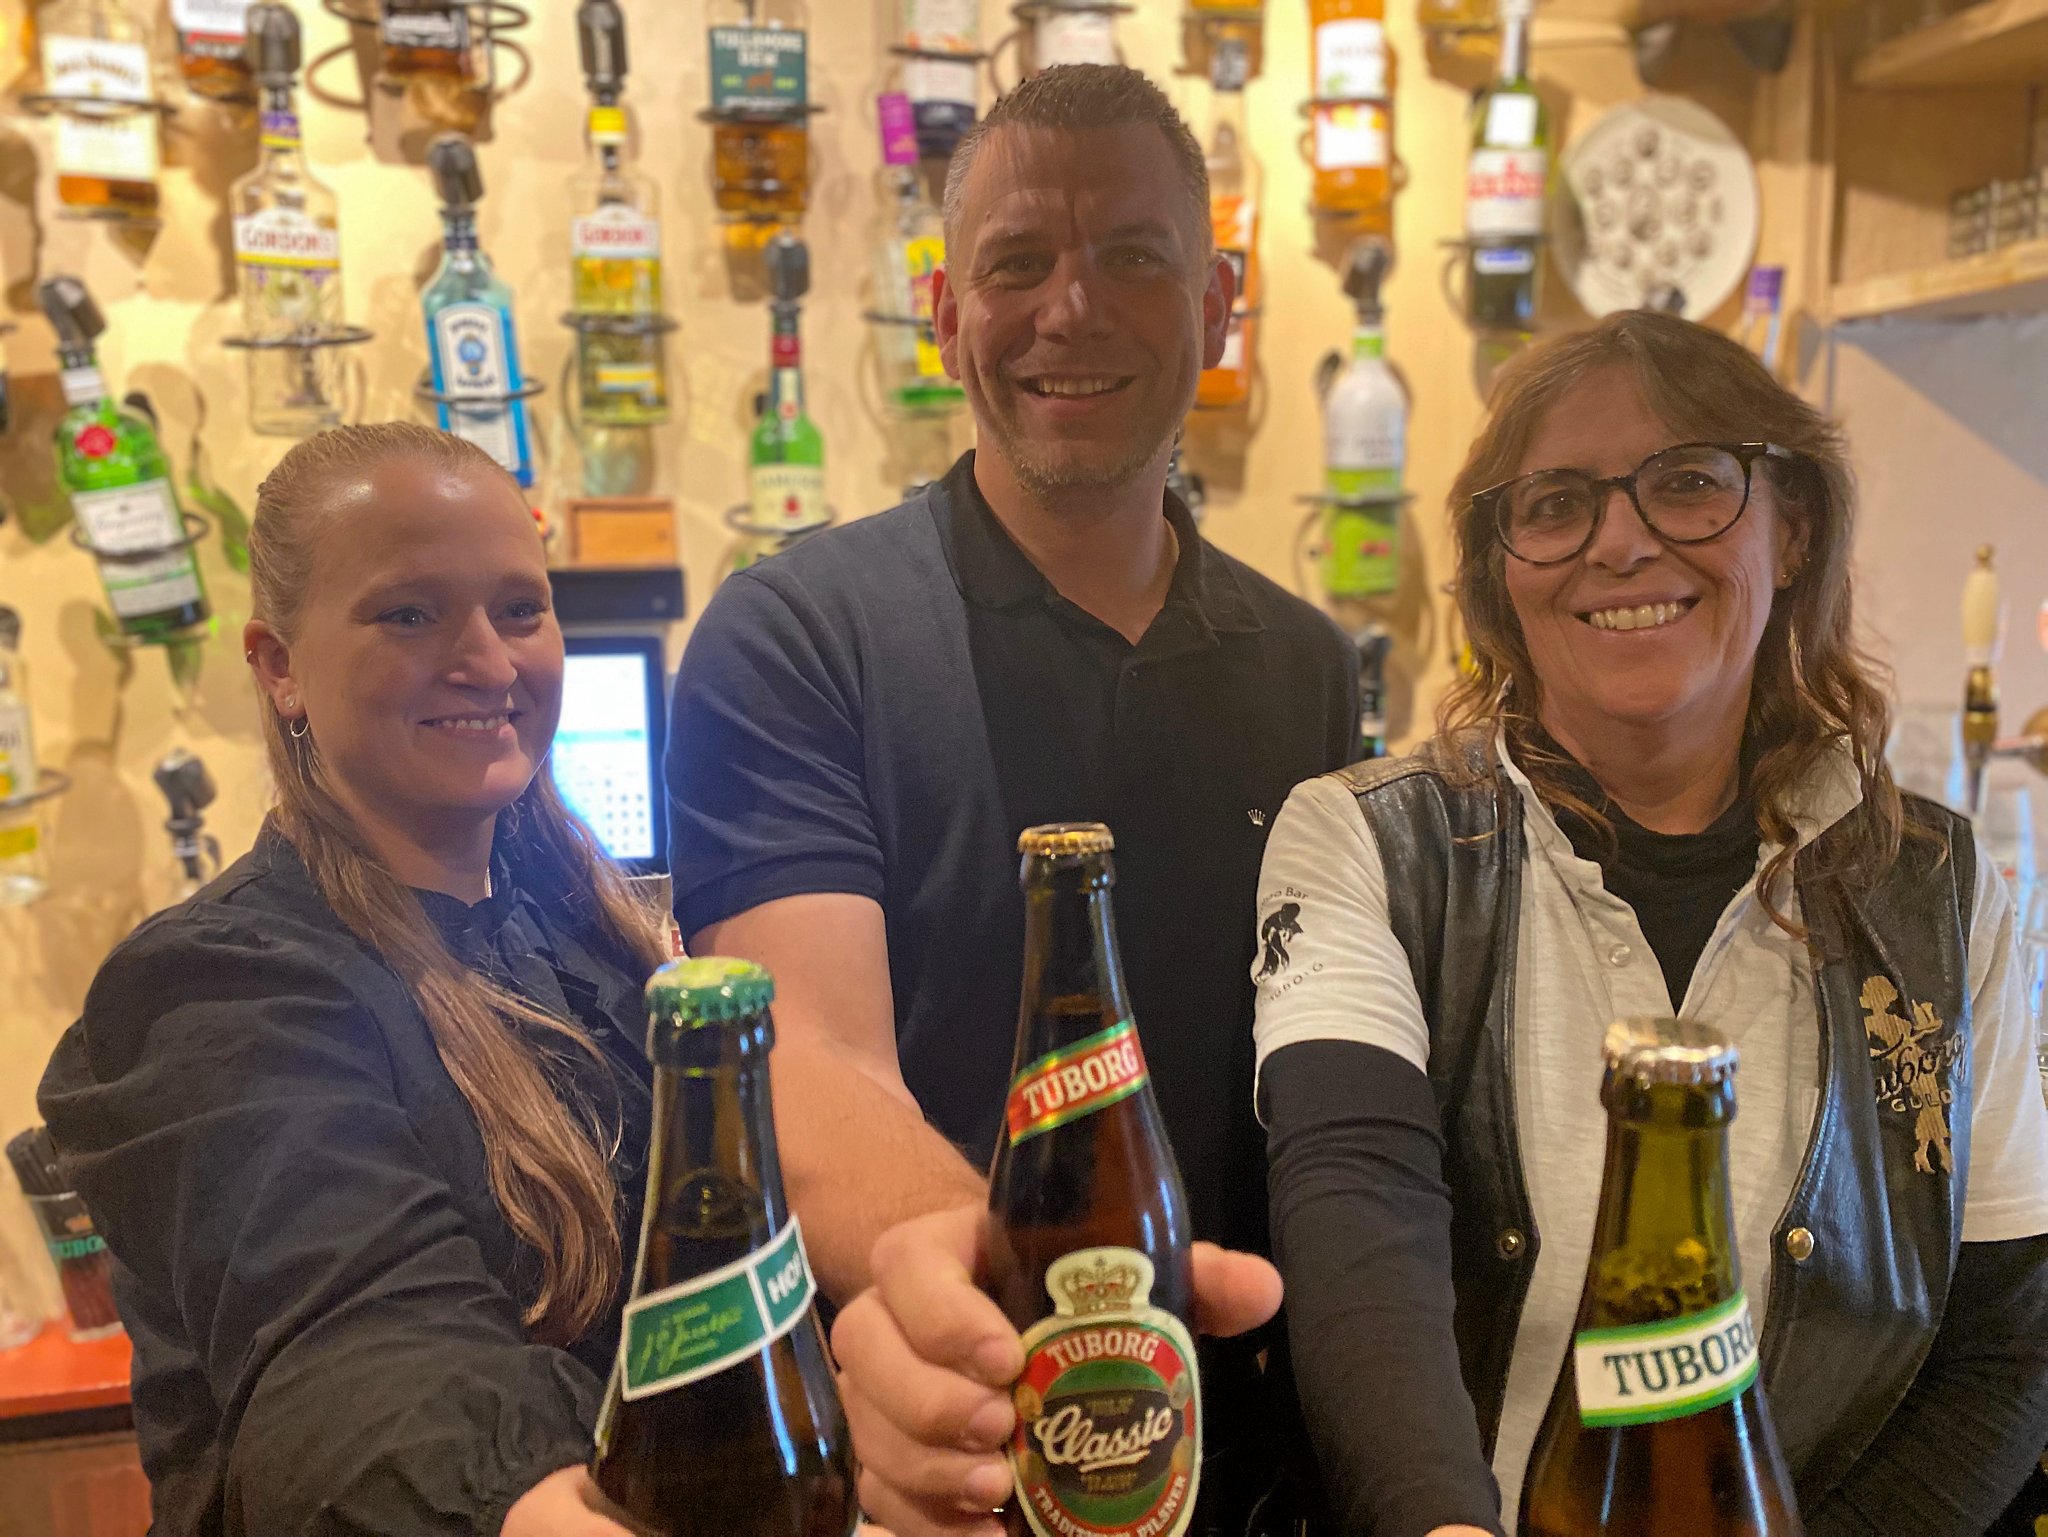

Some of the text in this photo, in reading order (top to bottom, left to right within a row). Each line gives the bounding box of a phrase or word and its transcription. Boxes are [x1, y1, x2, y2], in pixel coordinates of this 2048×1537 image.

[1284, 886, 1308, 900] Bar
[1022, 1038, 1139, 1119] TUBORG
[1891, 1088, 1953, 1113] GULD
[1046, 1330, 1160, 1369] TUBORG
[1033, 1403, 1174, 1466] Classic
